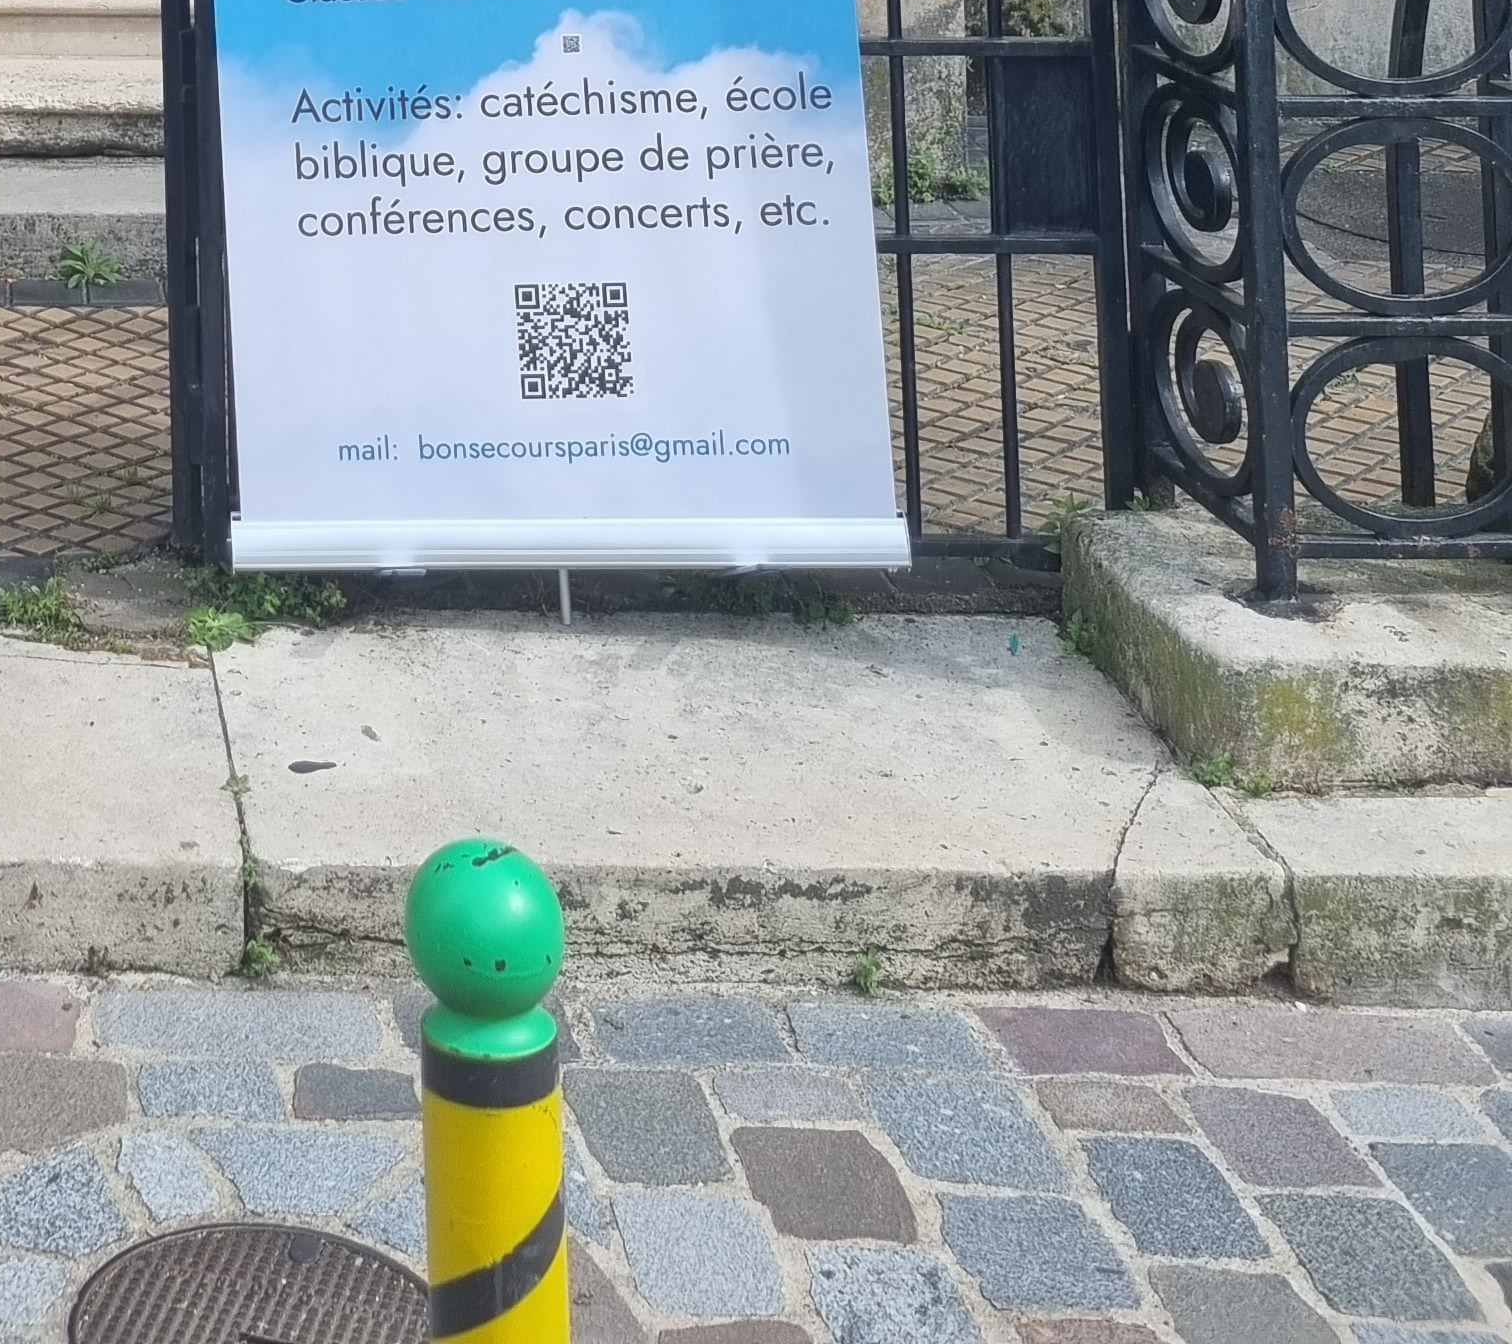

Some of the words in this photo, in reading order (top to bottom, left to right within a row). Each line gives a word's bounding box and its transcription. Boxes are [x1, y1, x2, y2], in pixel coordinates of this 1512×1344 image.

[292, 84, 461, 123] Activités:
[480, 78, 708, 120] catéchisme,
[727, 71, 831, 111] école
[296, 140, 464, 187] biblique,
[483, 148, 623, 185] groupe
[640, 133, 688, 171] de
[707, 133, 833, 179] prière,
[299, 196, 546, 238] conférences,
[565, 197, 742, 234] concerts,
[761, 195, 829, 226] etc.
[339, 435, 397, 460] mail:
[419, 430, 789, 464] bonsecoursparis@gmail.com
